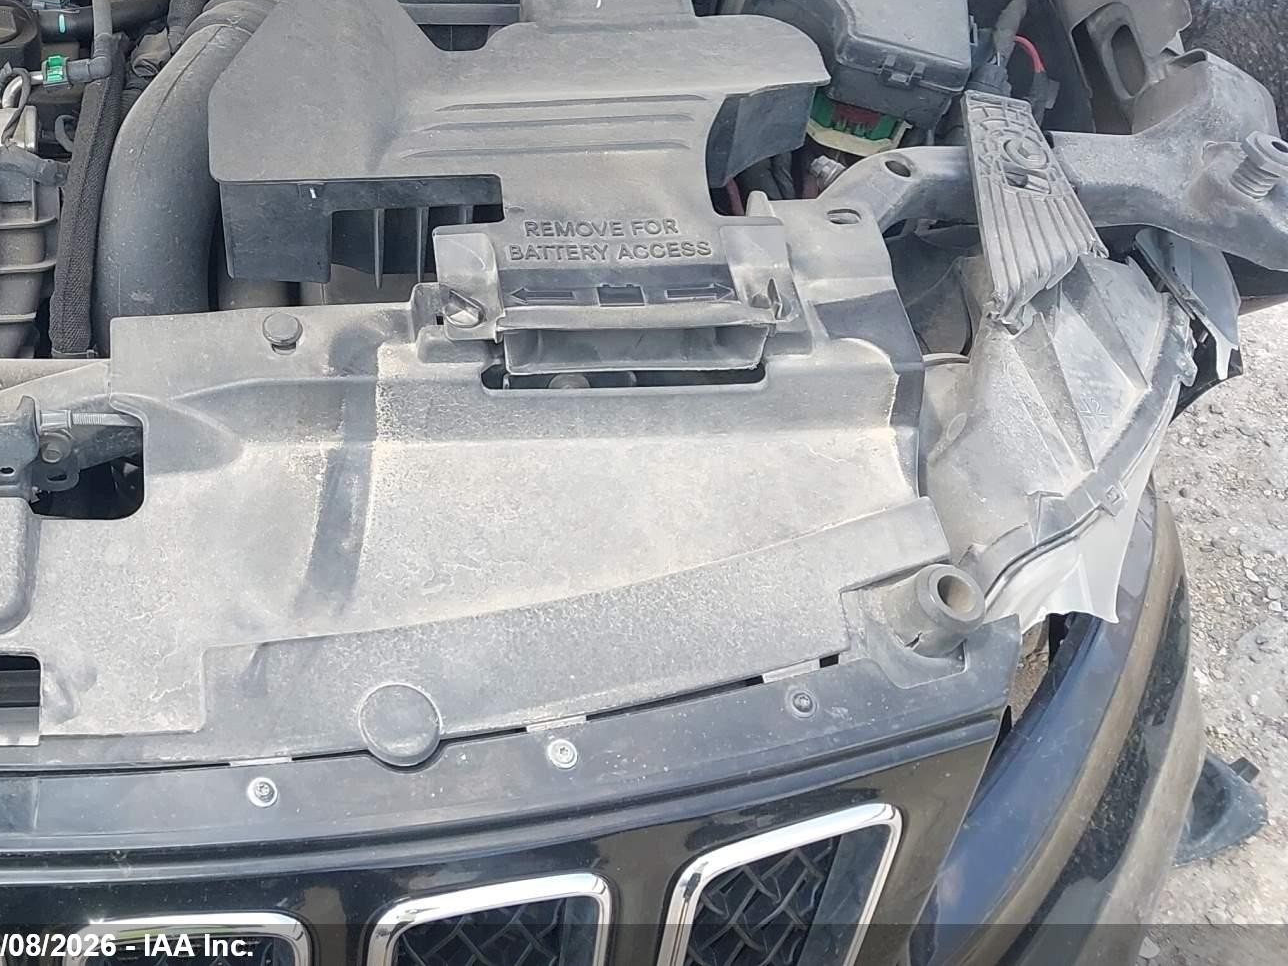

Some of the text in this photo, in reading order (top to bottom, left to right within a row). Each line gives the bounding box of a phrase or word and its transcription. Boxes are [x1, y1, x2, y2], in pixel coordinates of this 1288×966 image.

[524, 218, 679, 237] REMOVE FOR
[509, 241, 712, 261] BATTERY ACCESS
